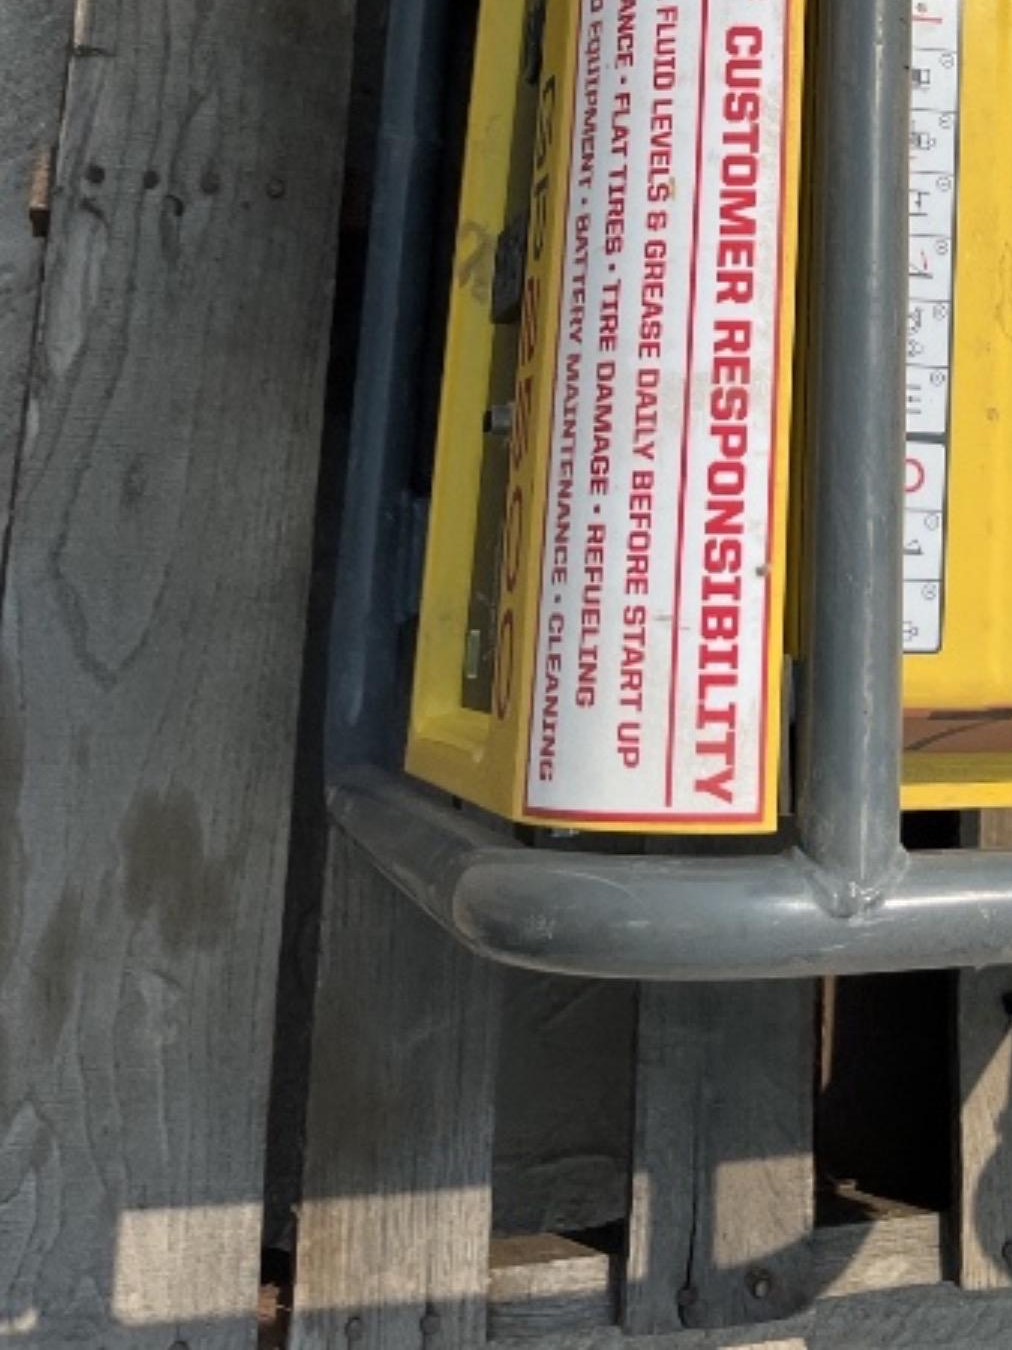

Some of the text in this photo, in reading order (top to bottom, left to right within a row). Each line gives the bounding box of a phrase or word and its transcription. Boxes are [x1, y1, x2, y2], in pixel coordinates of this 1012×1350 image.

[578, 21, 605, 188] EQUIPMENT
[652, 8, 679, 91] FLUID
[609, 92, 632, 159] FLAT
[648, 99, 674, 201] LEVELS
[603, 165, 628, 256] TIRES
[646, 211, 669, 232] &
[568, 213, 593, 345] BATTERY
[598, 279, 622, 352] TIRE
[637, 239, 667, 359] GREASE
[551, 353, 585, 586] MAINTENANCE
[588, 362, 617, 496] DAMAGE
[632, 368, 660, 461] DAILY
[694, 25, 764, 805] CUSTOMER RESPONSIBILITY
[624, 470, 654, 595] BEFORE
[575, 523, 607, 707] REFUELING
[619, 605, 648, 712] START
[538, 612, 567, 782] CLEANING
[616, 722, 641, 769] UP
